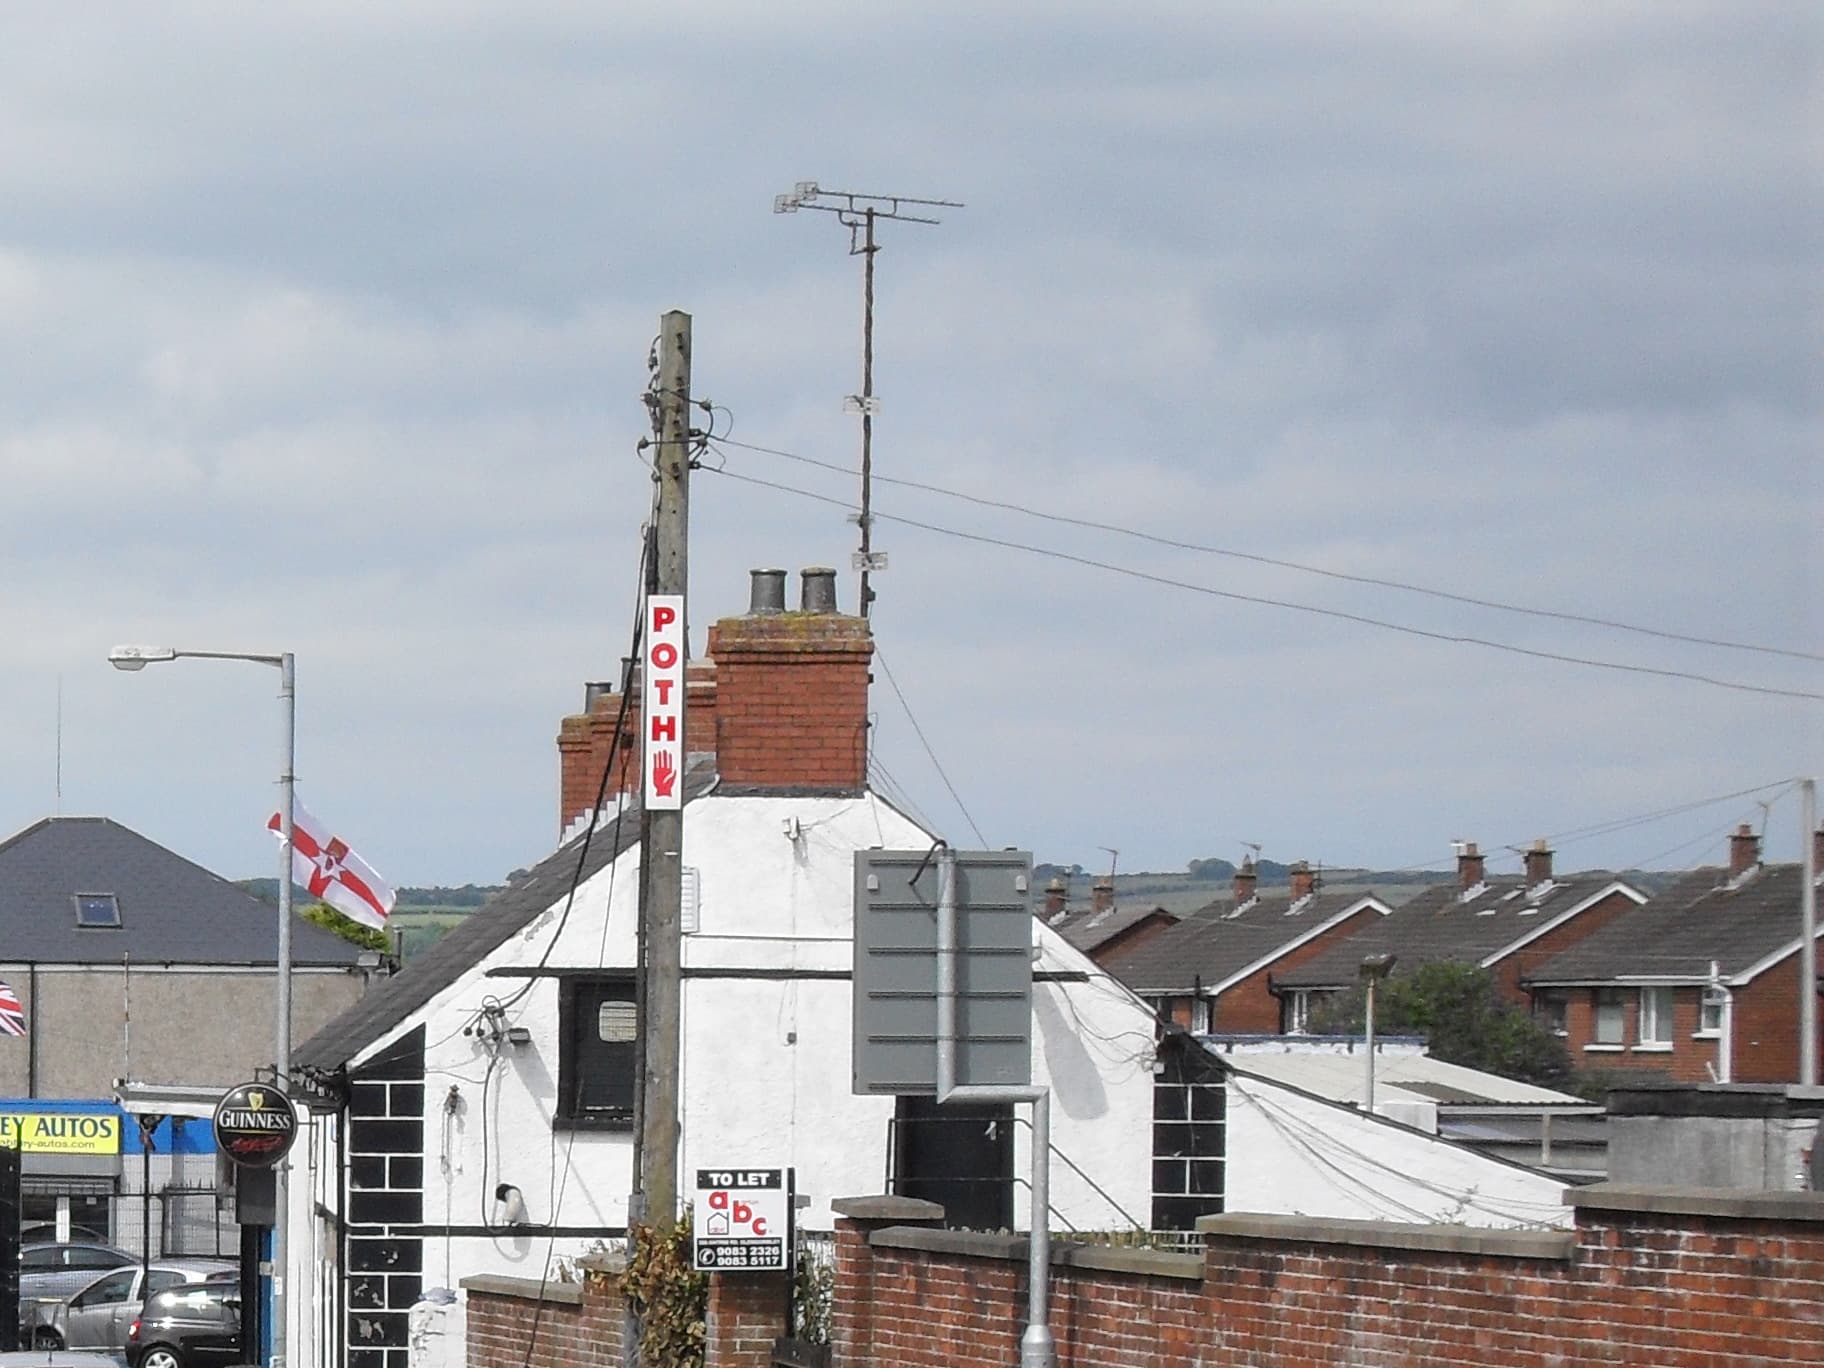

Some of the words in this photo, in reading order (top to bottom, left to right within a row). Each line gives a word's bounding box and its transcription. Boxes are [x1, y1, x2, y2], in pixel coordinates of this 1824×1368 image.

[651, 606, 678, 741] POTH
[35, 1117, 112, 1139] AUTOS
[219, 1110, 291, 1129] GUINNESS
[709, 1173, 733, 1186] TO
[737, 1173, 770, 1186] LET
